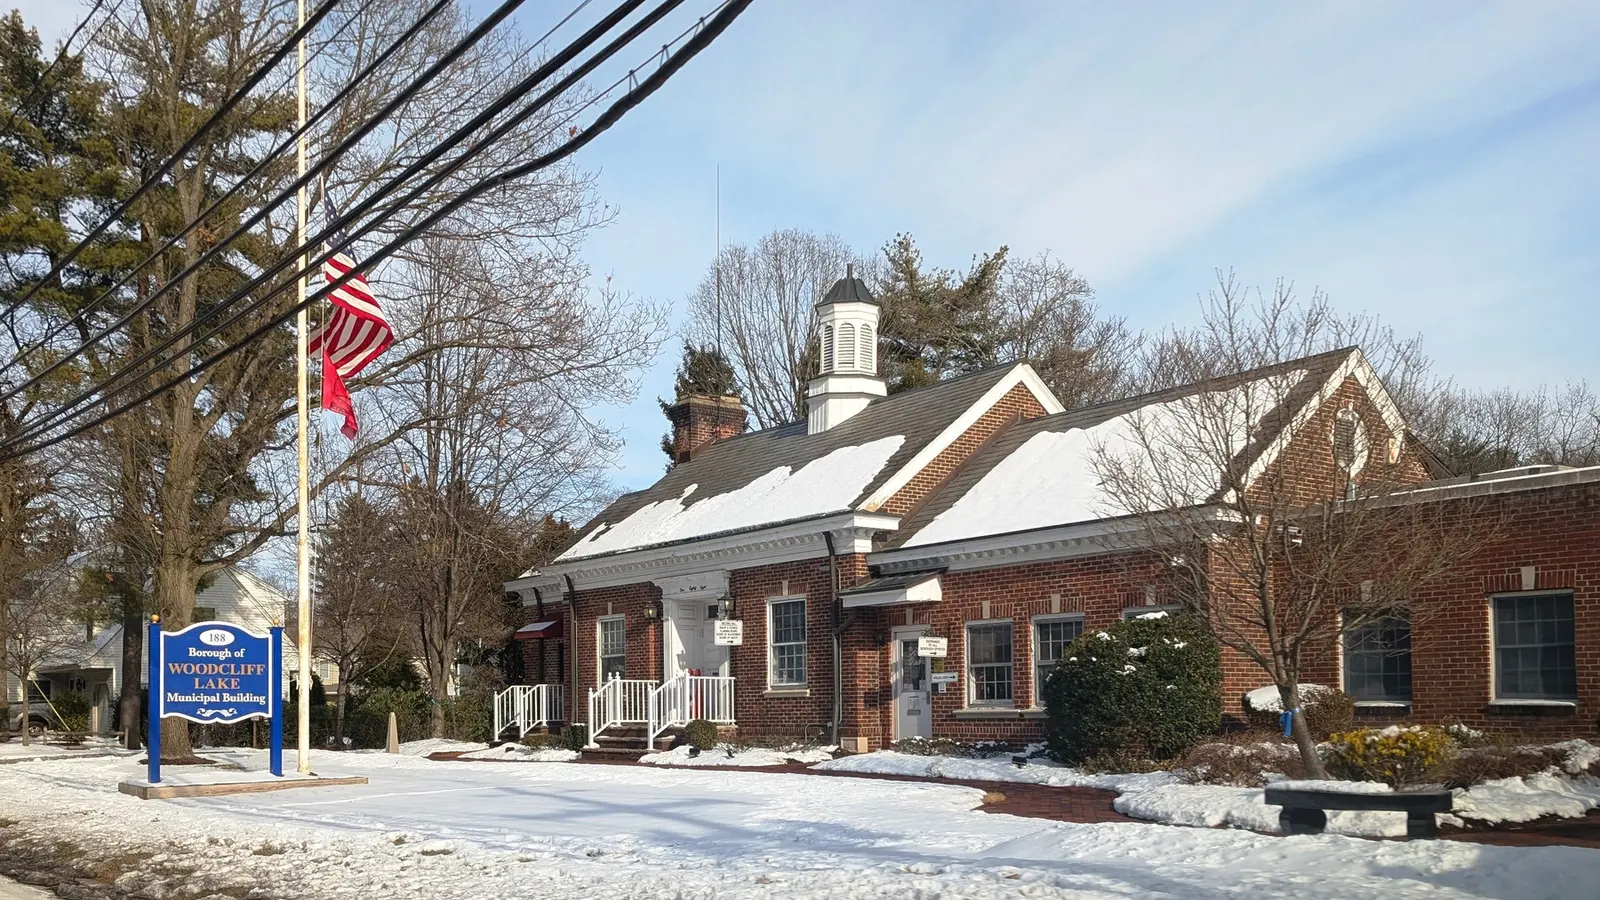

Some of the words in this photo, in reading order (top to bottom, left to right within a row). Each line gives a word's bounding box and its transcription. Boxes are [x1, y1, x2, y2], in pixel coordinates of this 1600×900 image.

[209, 633, 226, 642] 188
[188, 647, 231, 660] Borough
[234, 648, 245, 658] of
[168, 663, 266, 675] WOODCLIFF
[194, 678, 240, 689] LAKE
[167, 692, 220, 704] Municipal
[222, 692, 266, 705] Building
